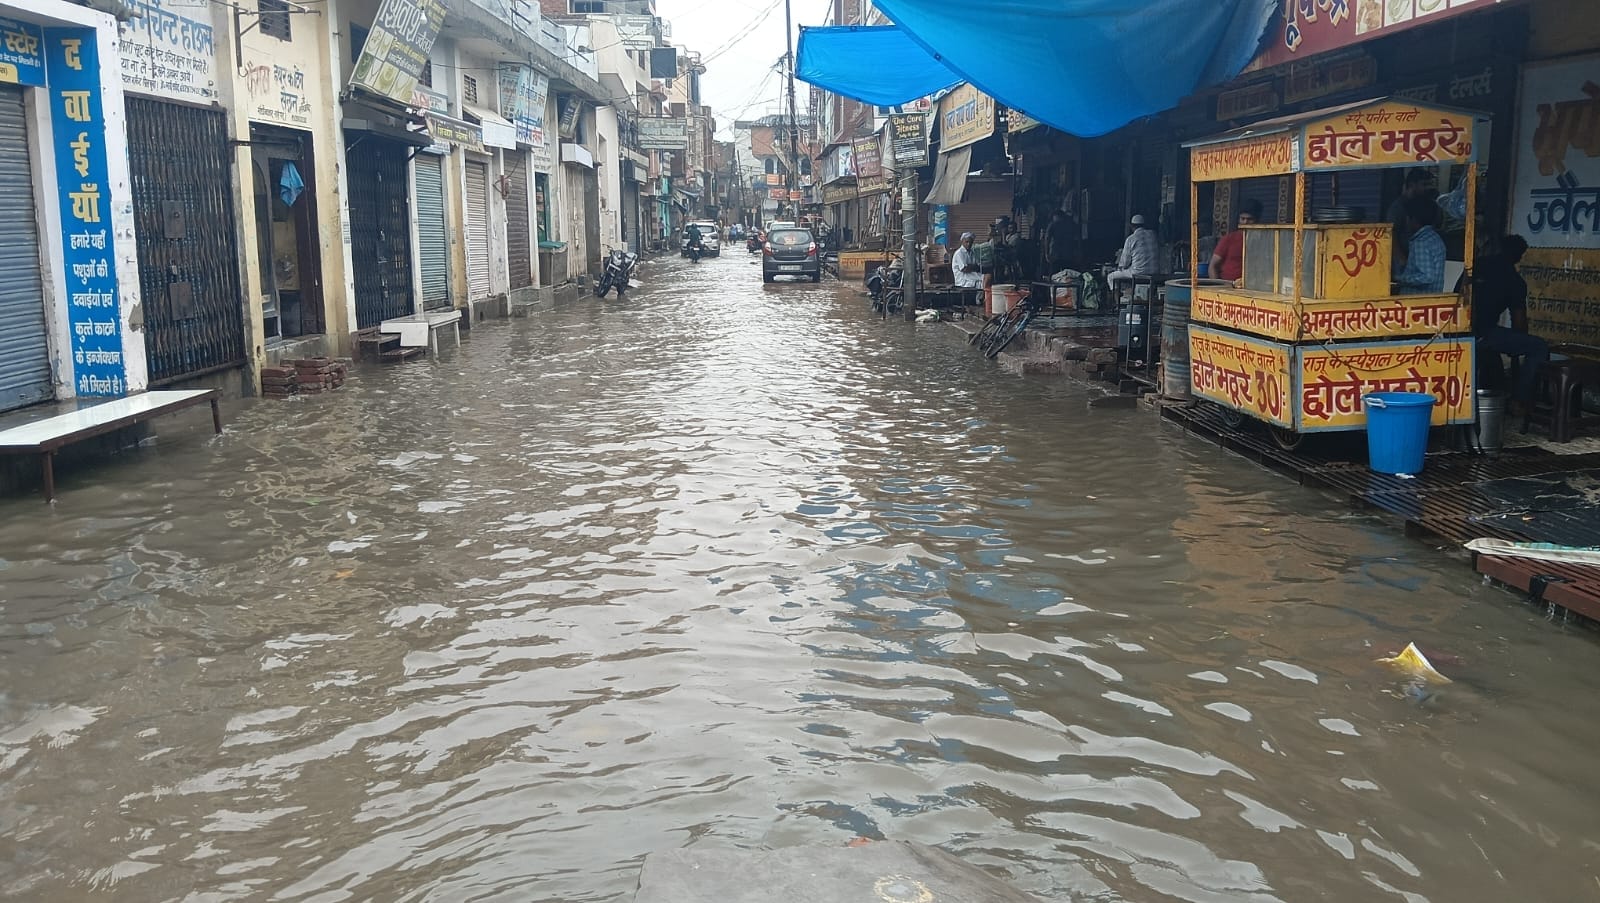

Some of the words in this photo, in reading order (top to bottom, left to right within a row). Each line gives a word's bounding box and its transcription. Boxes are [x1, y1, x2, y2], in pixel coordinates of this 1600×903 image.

[4, 26, 38, 56] स्टोर
[1366, 108, 1394, 124] पनीर
[1395, 107, 1420, 122] वाले
[1278, 136, 1291, 164] 30
[1381, 118, 1465, 163] भठूरे
[1456, 142, 1472, 156] 30
[70, 230, 90, 249] हमारे
[73, 258, 96, 285] पशुओं
[97, 259, 108, 278] की
[101, 287, 113, 307] एवं
[1223, 298, 1257, 328] अमृतसरी
[1256, 307, 1281, 331] नान
[1303, 302, 1380, 336] अमृतसरी
[1411, 302, 1461, 327] नान
[75, 317, 93, 343] कुत्ते
[94, 319, 116, 337] काटने
[76, 346, 84, 365] के
[1211, 336, 1234, 360] स्पेशल
[1234, 343, 1256, 368] पनीर
[1257, 349, 1275, 373] वाले
[1303, 355, 1327, 374] राजू
[1329, 350, 1342, 369] के
[1345, 349, 1393, 370] स्पेशल
[1395, 346, 1432, 367] पनीर
[1433, 344, 1464, 364] वाले
[79, 374, 89, 394] भी
[90, 374, 111, 396] मिलते
[1216, 364, 1253, 406] भठूरे
